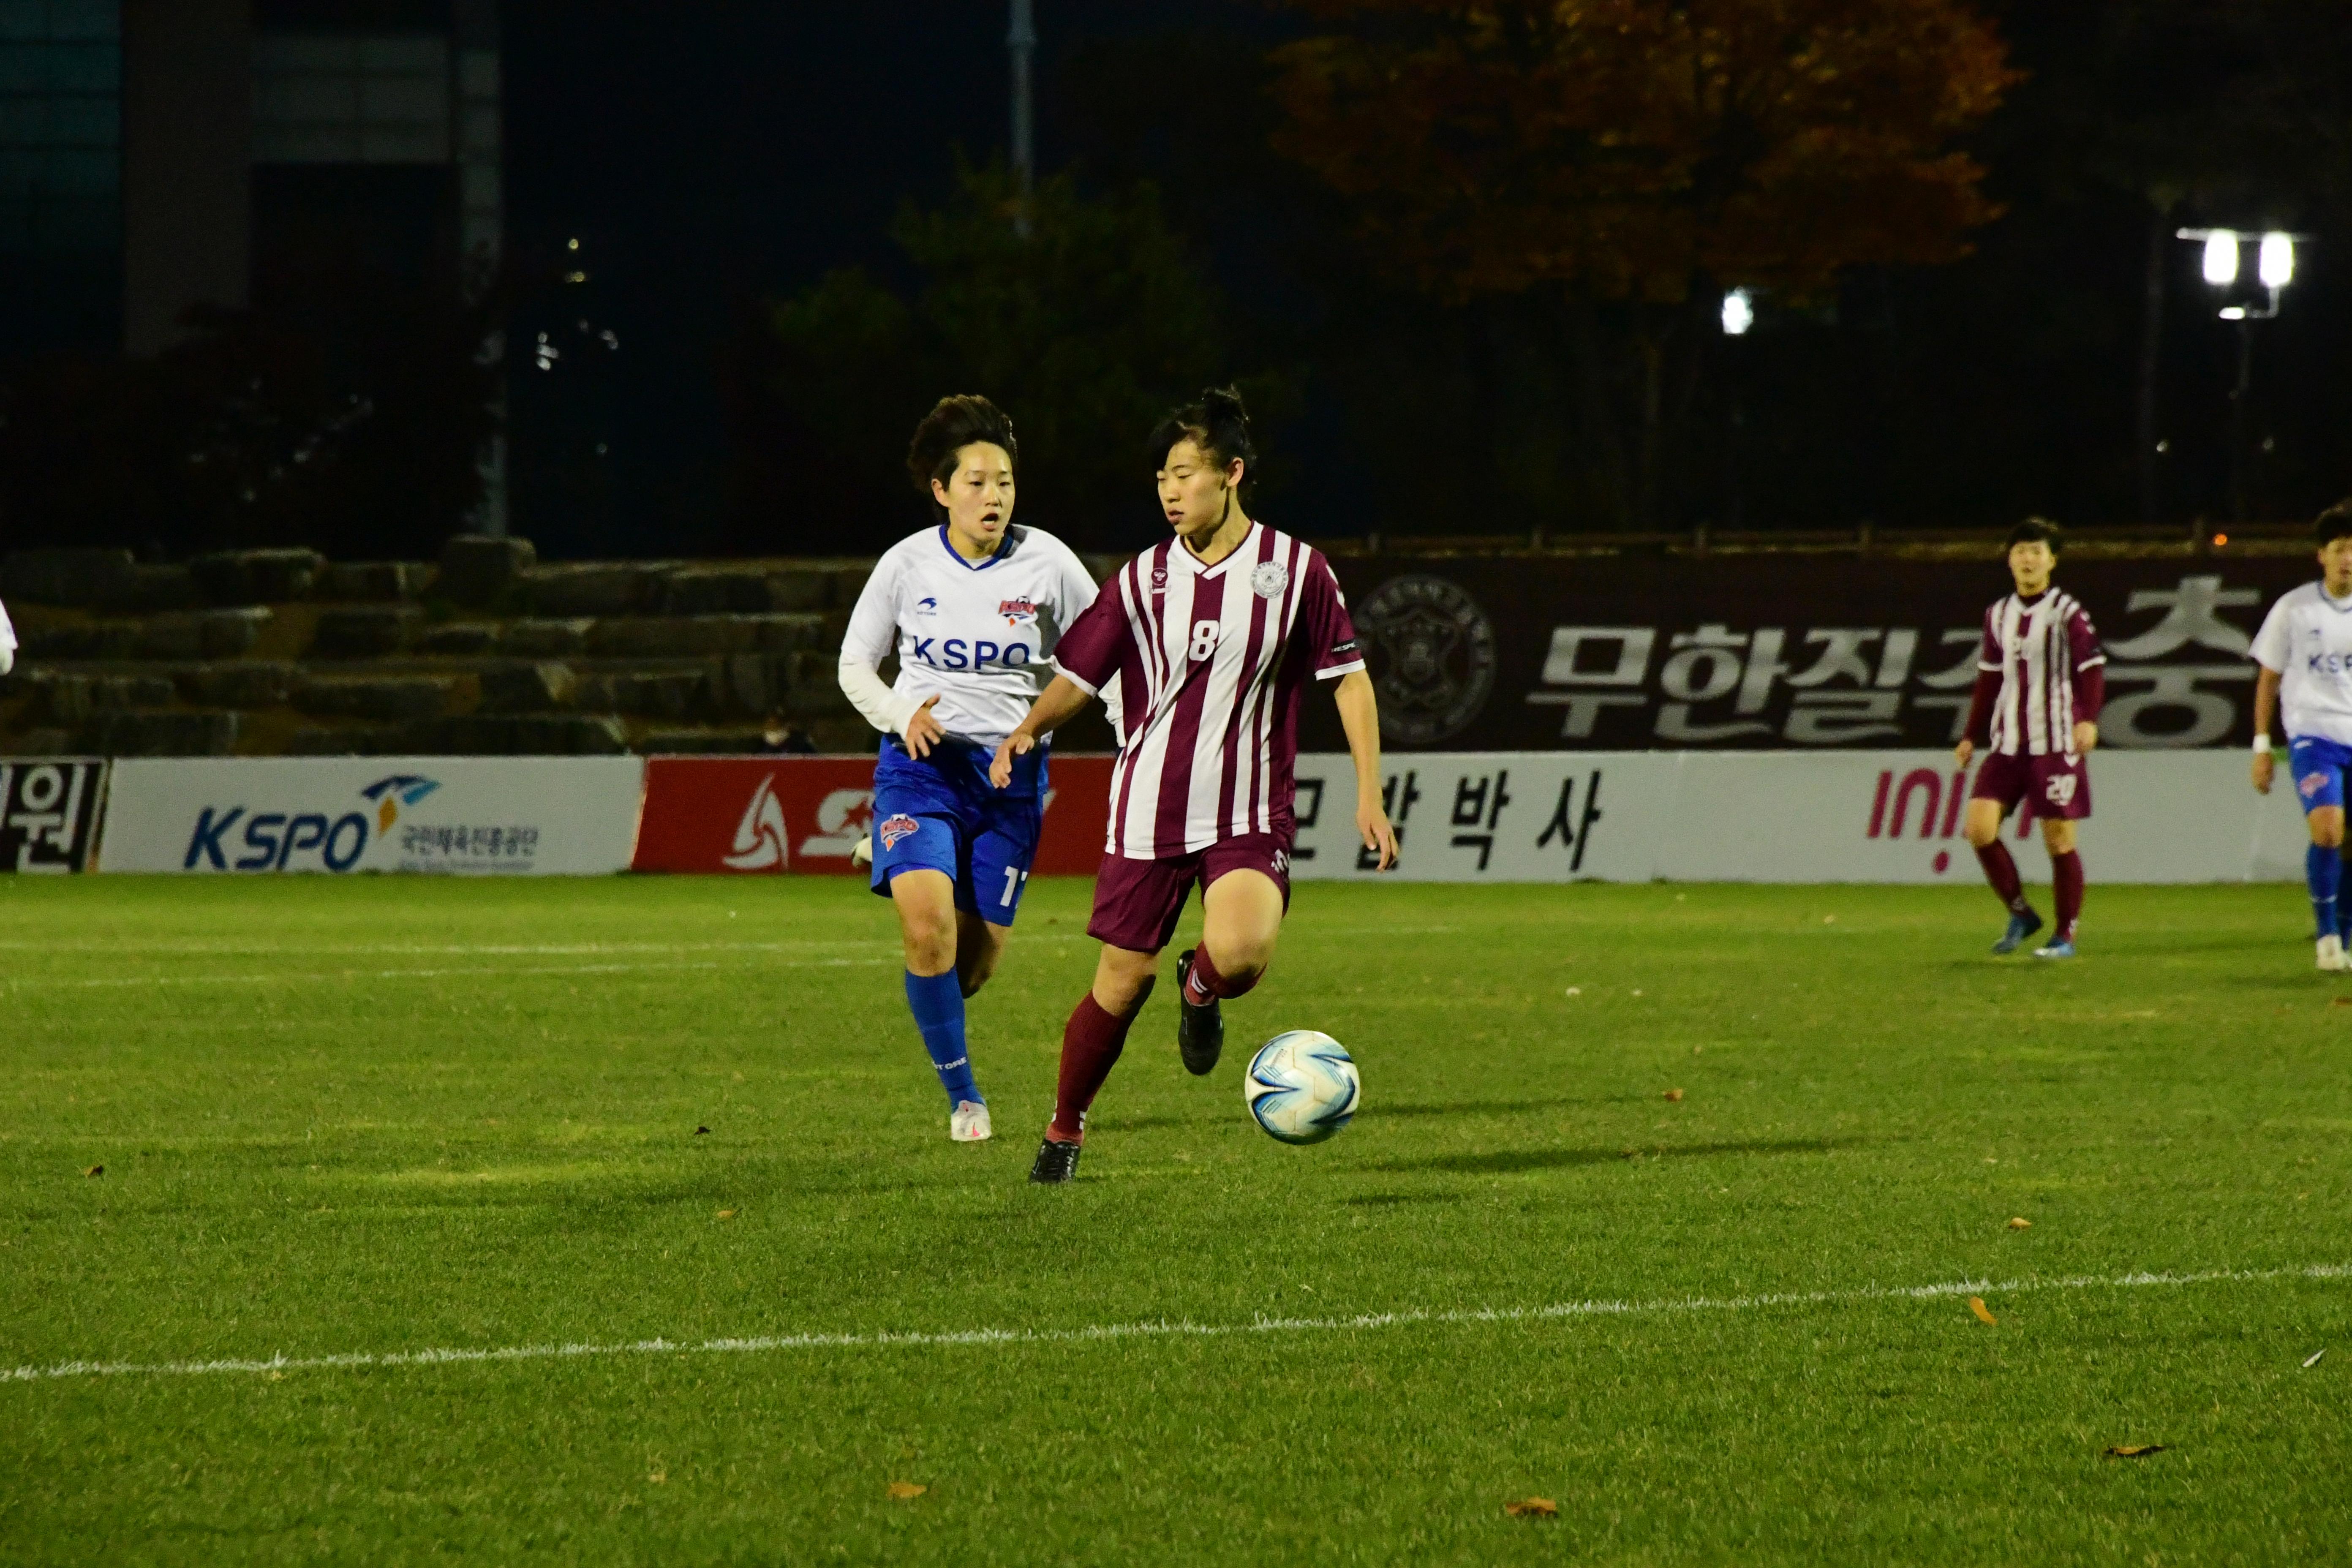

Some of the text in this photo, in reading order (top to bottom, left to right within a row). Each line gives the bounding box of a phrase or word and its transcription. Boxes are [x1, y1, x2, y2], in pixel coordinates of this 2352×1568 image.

[913, 635, 1030, 670] KSPO
[1189, 620, 1220, 662] 8
[2047, 774, 2077, 806] 20
[183, 807, 368, 870] KSPO
